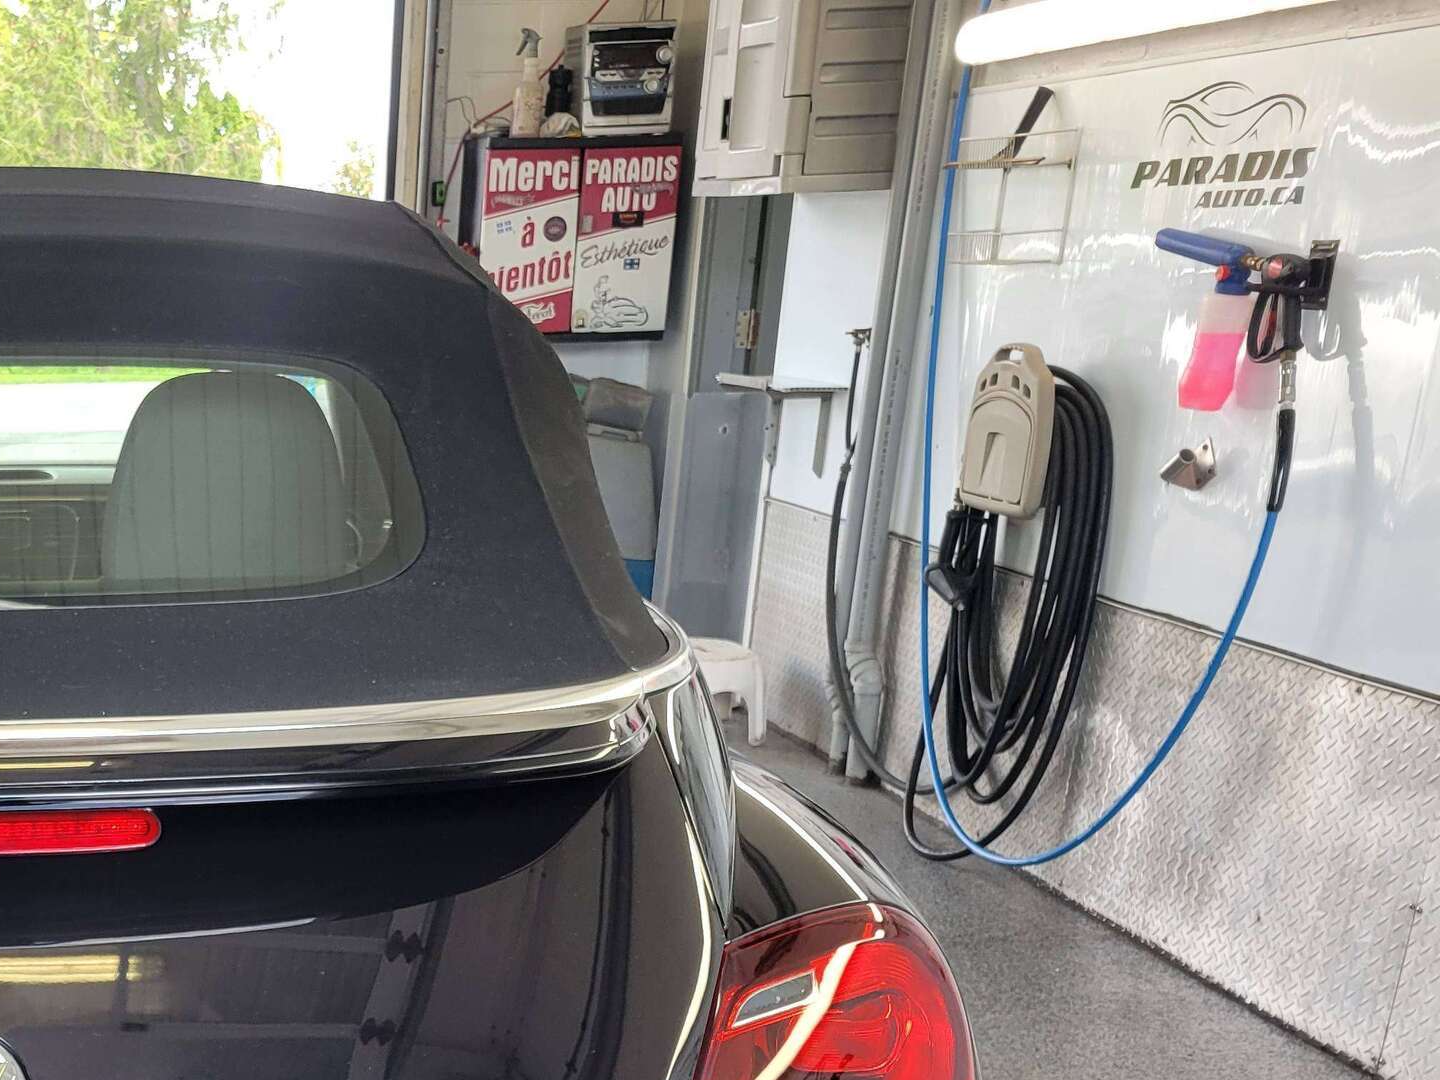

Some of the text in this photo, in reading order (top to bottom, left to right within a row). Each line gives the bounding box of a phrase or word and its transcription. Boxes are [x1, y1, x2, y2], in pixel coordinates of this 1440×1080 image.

[488, 156, 579, 193] Merci
[585, 154, 679, 185] PARADIS
[1130, 147, 1317, 189] PARADIS
[600, 187, 657, 213] AUTO
[1194, 186, 1305, 209] AUTO.CA
[521, 215, 535, 248] à
[581, 235, 670, 269] Esthétique
